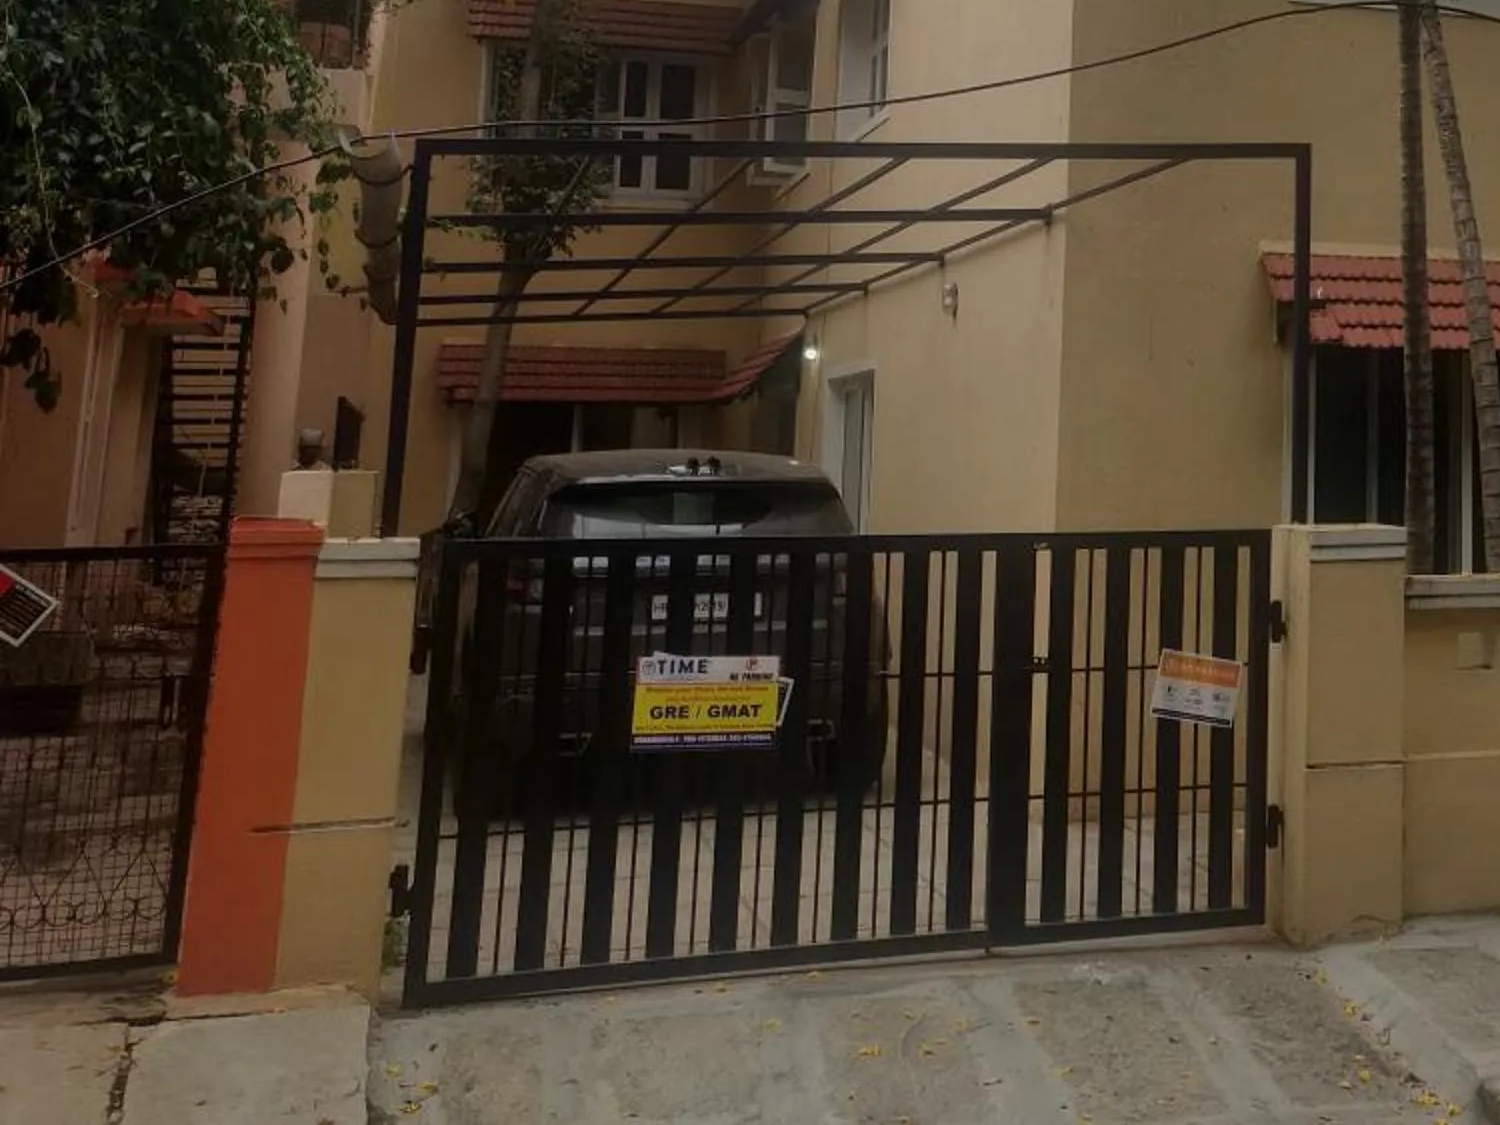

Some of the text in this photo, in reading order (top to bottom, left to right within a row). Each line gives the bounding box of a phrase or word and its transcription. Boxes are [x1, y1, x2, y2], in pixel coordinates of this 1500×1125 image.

[657, 658, 709, 675] TIME
[649, 706, 689, 720] GRE
[707, 704, 763, 719] GMAT
